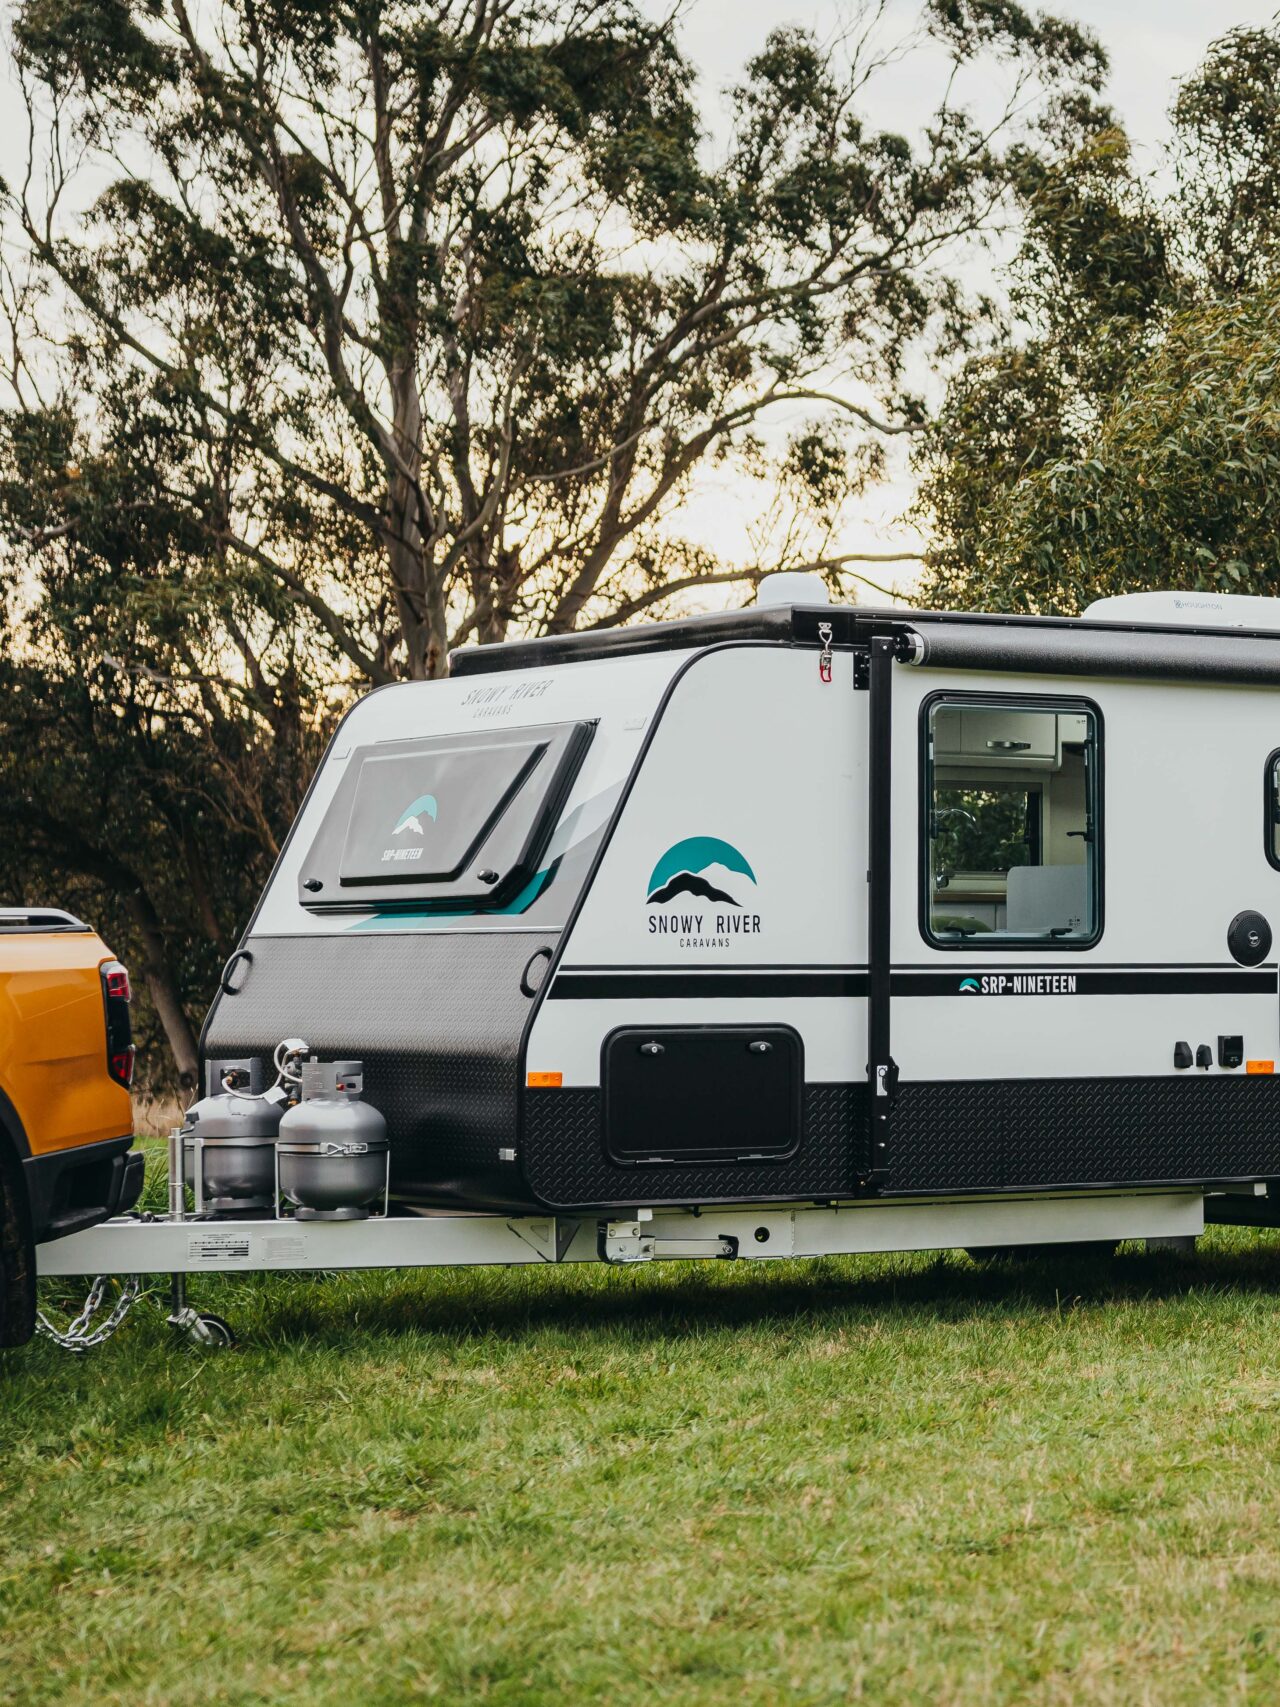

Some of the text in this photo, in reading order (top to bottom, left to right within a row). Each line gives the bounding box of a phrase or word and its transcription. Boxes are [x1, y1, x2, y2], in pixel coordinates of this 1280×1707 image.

[461, 679, 554, 705] SNOWY RIVER
[648, 914, 761, 933] SNOWY RIVER
[679, 938, 730, 948] CARAVANS
[981, 976, 1077, 993] SRP-NINETEEN
